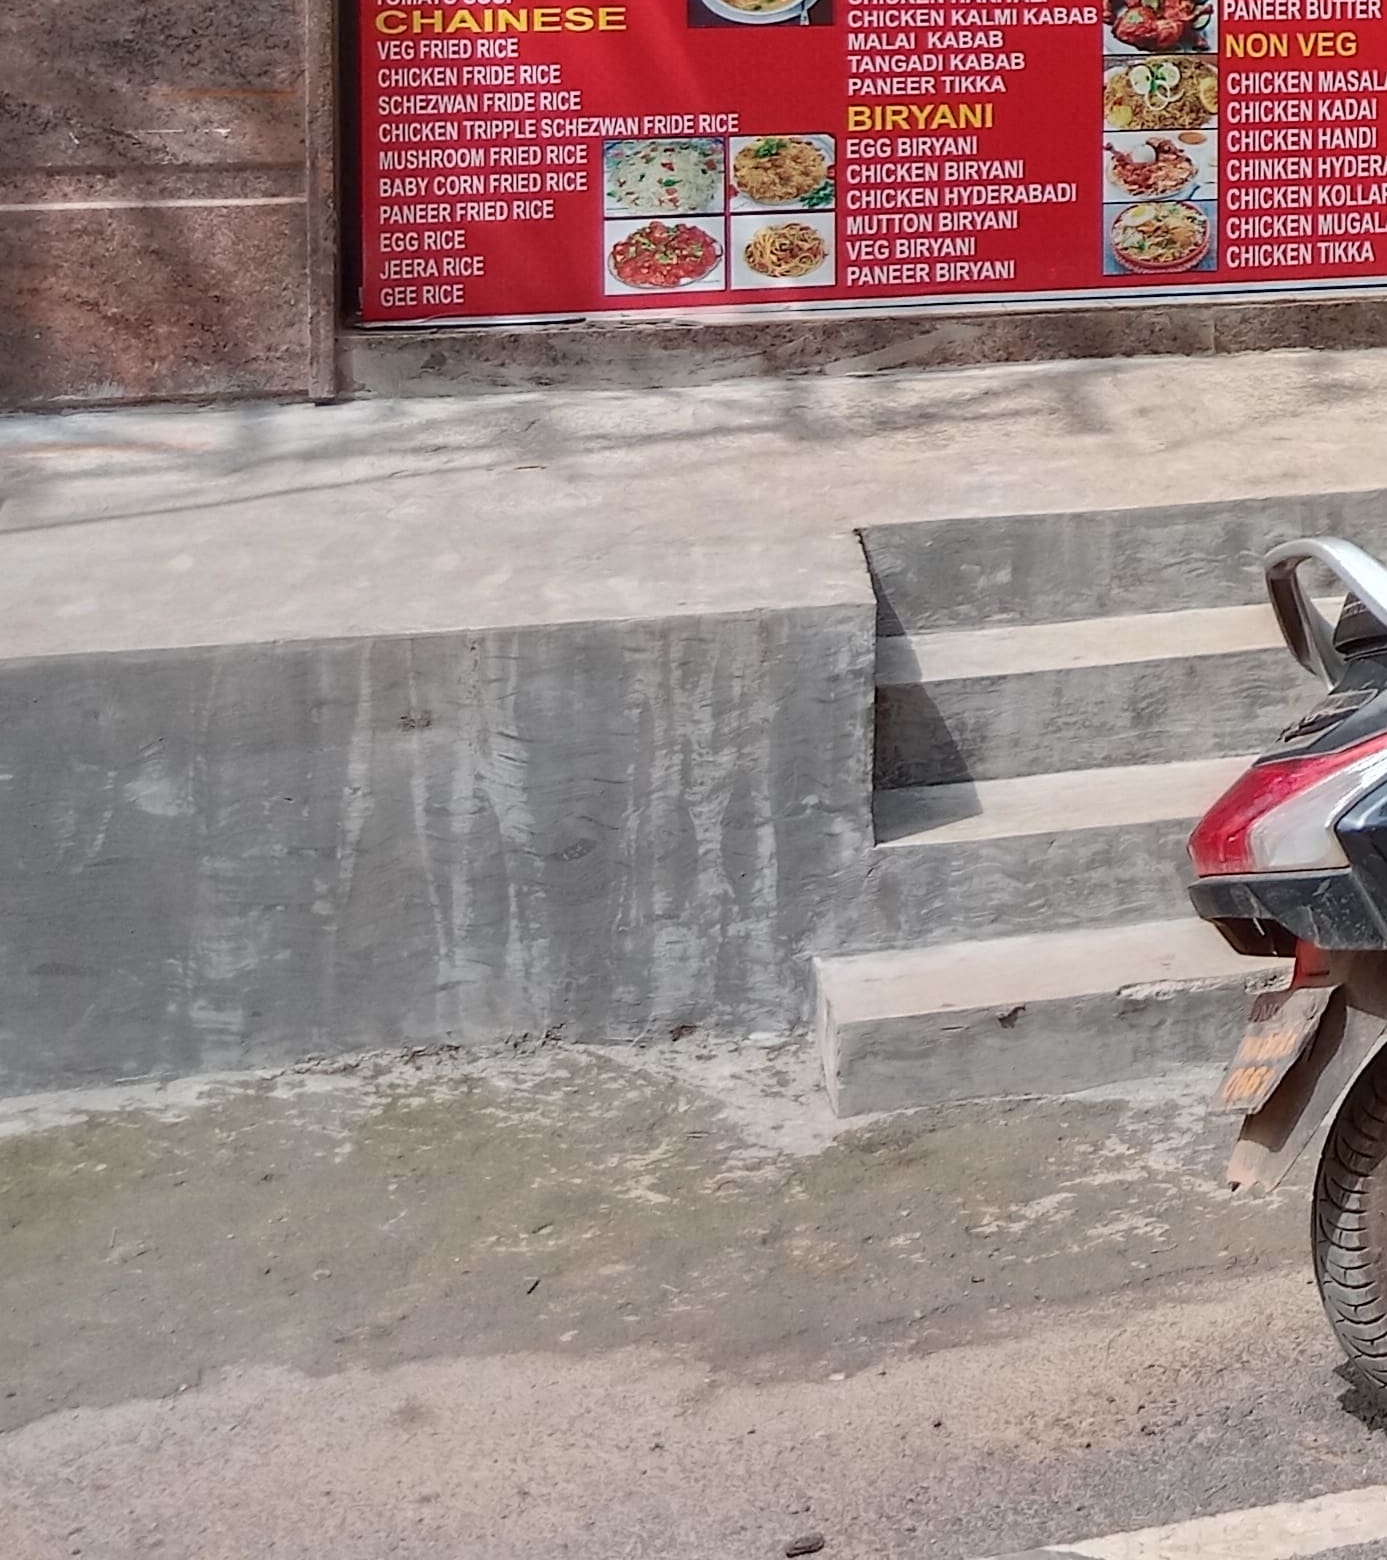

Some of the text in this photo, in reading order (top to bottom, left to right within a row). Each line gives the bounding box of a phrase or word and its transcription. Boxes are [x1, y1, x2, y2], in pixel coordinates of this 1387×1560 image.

[375, 7, 627, 34] CHAINESE
[847, 6, 1098, 28] CHICKEN KALMI KABAB
[377, 37, 519, 60] VEG FRIED RICE
[847, 30, 1004, 51] MALAI KABAB
[1225, 31, 1357, 58] NON VEG
[847, 52, 1025, 73] TANGADI KABAB
[377, 64, 561, 88] CHICKEN FRIDE RICE
[848, 75, 1006, 96] PANEER TIKKA
[1226, 70, 1313, 95] CHICKEN
[378, 90, 581, 116] SCHEZWAN FRIDE RICE
[1226, 98, 1377, 124] CHICKEN KADAI
[378, 113, 739, 143] CHICKEN TRIPPLE SCHEZWAN FRIDE RICE
[847, 103, 993, 132] BIRYANI
[1226, 126, 1377, 153] CHICKEN HANDI
[379, 144, 588, 170] MUSHROOM FRIED RICE
[1226, 157, 1313, 182] CHINKEN
[379, 171, 588, 198] BABY CORN FRIED RICE
[846, 159, 1024, 185] CHICKEN BIRYANI
[846, 182, 1077, 210] CHICKEN HYDERABADI
[1226, 185, 1313, 211] CHICKEN
[380, 199, 554, 225] PANEER FRIED RICE
[846, 209, 1018, 236] MUTTON BIRYANI
[1226, 214, 1313, 240] CHICKEN
[1226, 240, 1375, 268] CHICKEN TIKKA
[379, 256, 484, 280] JEERA RICE
[846, 259, 1015, 286] PANEER BIRYANI
